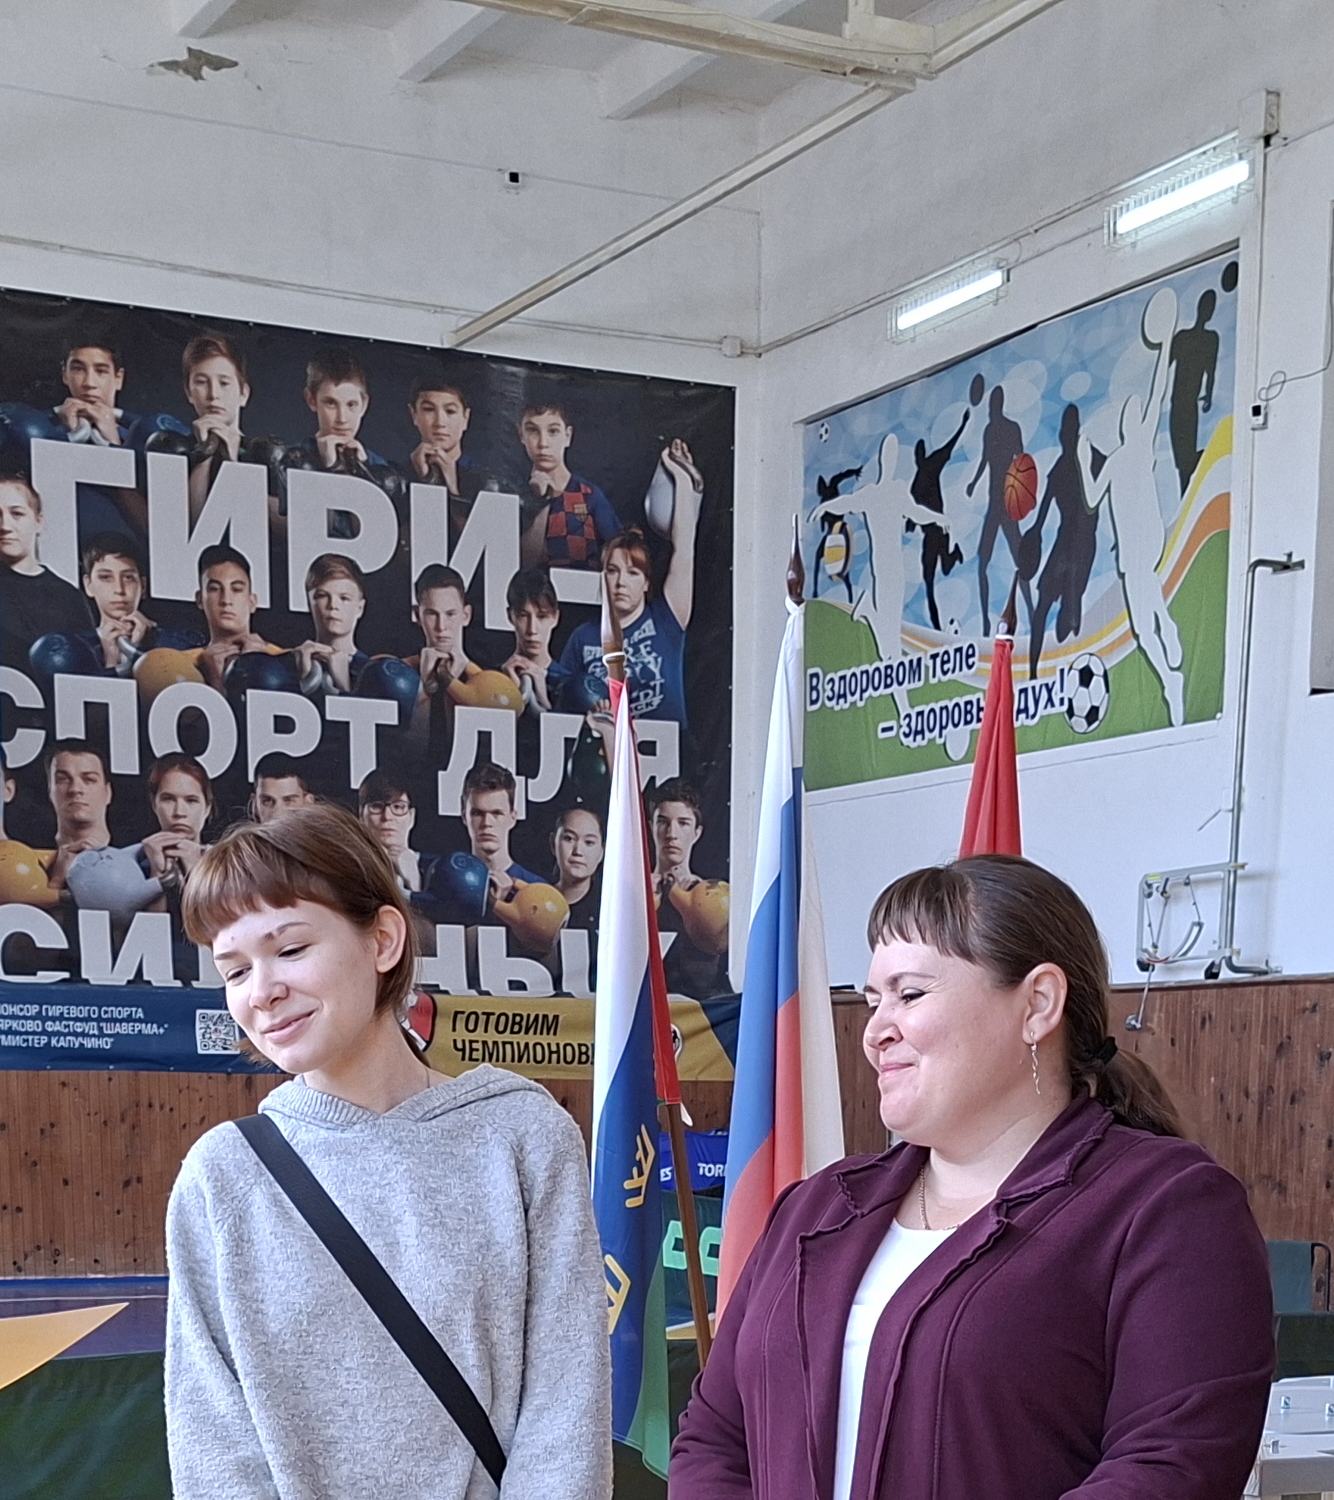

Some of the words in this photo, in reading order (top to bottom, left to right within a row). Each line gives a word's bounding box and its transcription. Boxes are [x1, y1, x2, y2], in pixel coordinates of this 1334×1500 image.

[30, 436, 603, 632] ГИРИ-
[809, 672, 821, 706] В
[826, 656, 923, 706] здоровом
[929, 643, 977, 679] теле
[902, 696, 985, 742] здоров
[1015, 668, 1066, 722] дух!
[42, 1005, 99, 1018] ГИРЕВОГО
[101, 1007, 145, 1019] СПОРТА
[451, 1010, 560, 1036] ГОТОВИМ
[44, 1021, 98, 1035] ФАСТФУД
[697, 1162, 727, 1177] TOR
